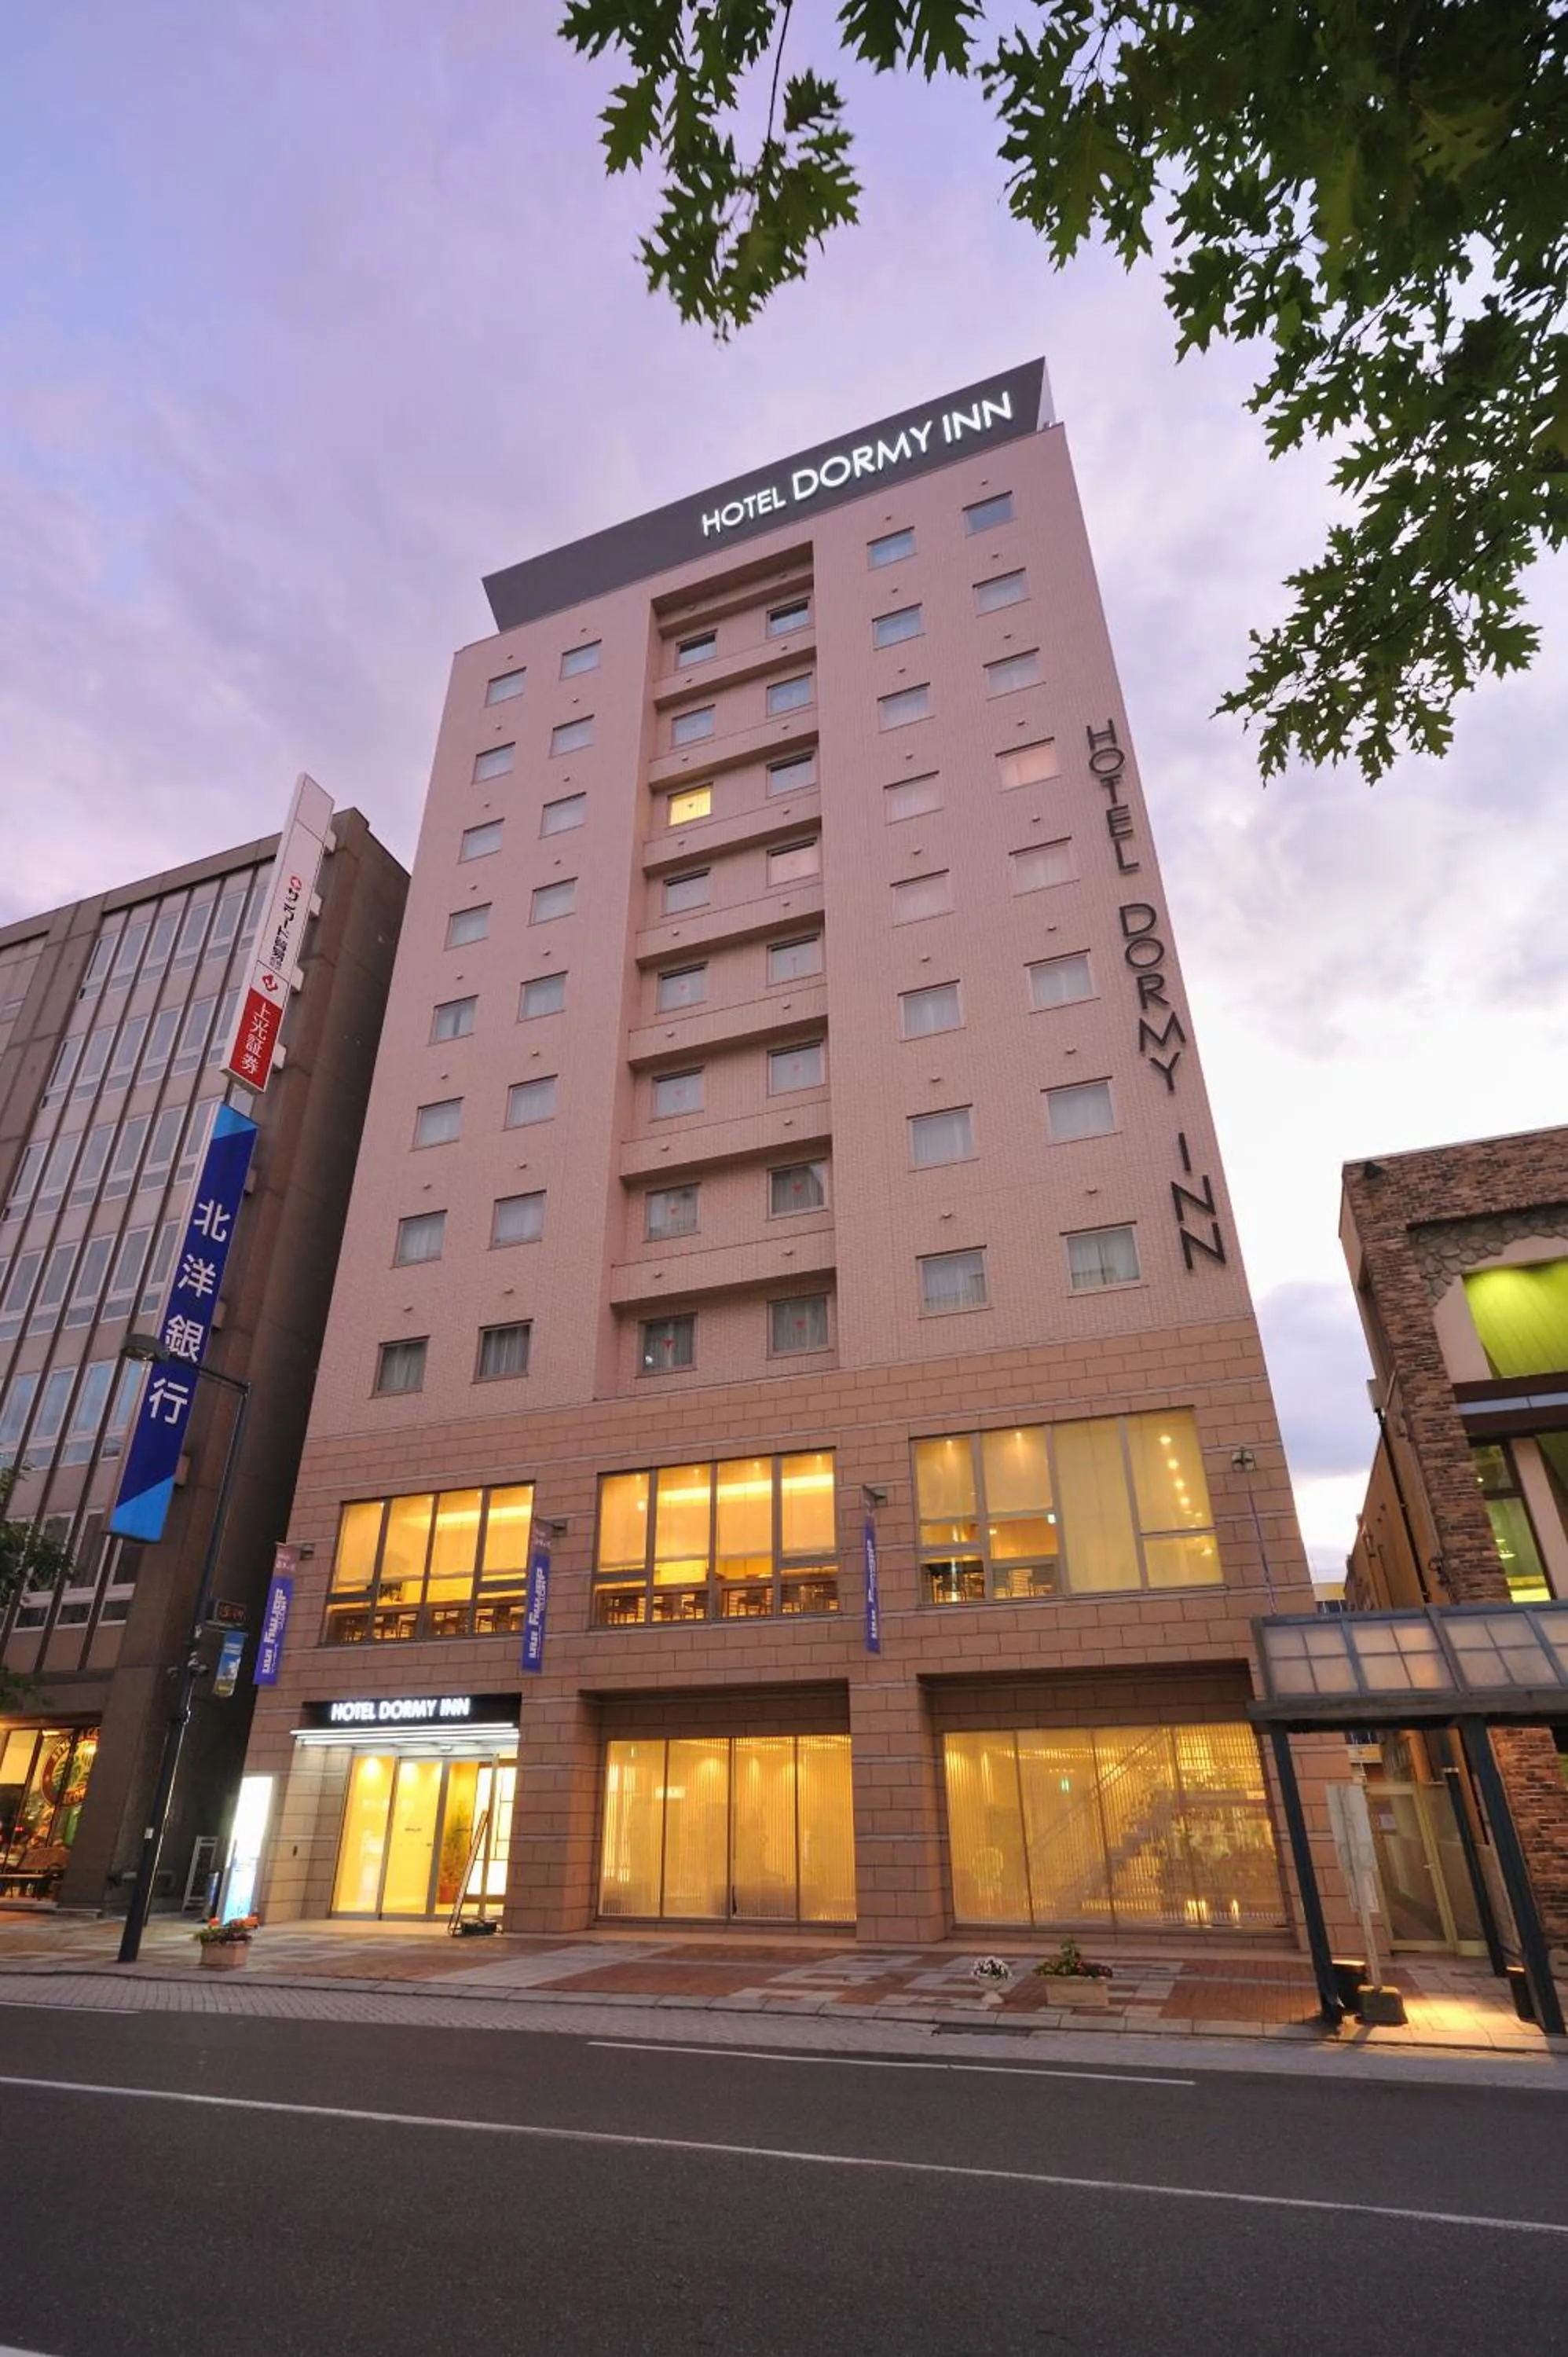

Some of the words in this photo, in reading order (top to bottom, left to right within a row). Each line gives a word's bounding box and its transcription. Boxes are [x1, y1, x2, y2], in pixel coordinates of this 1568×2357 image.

[702, 486, 786, 537] HOTEL
[791, 420, 932, 500] DORMY
[943, 391, 1013, 444] INN
[1086, 718, 1139, 874] HOTEL
[1119, 903, 1187, 1095] DORMY
[1170, 1131, 1227, 1270] INN
[148, 1199, 228, 1424] 北洋銀行
[331, 1701, 376, 1721] HOTEL
[379, 1699, 438, 1721] DORMY
[440, 1697, 471, 1717] INN
